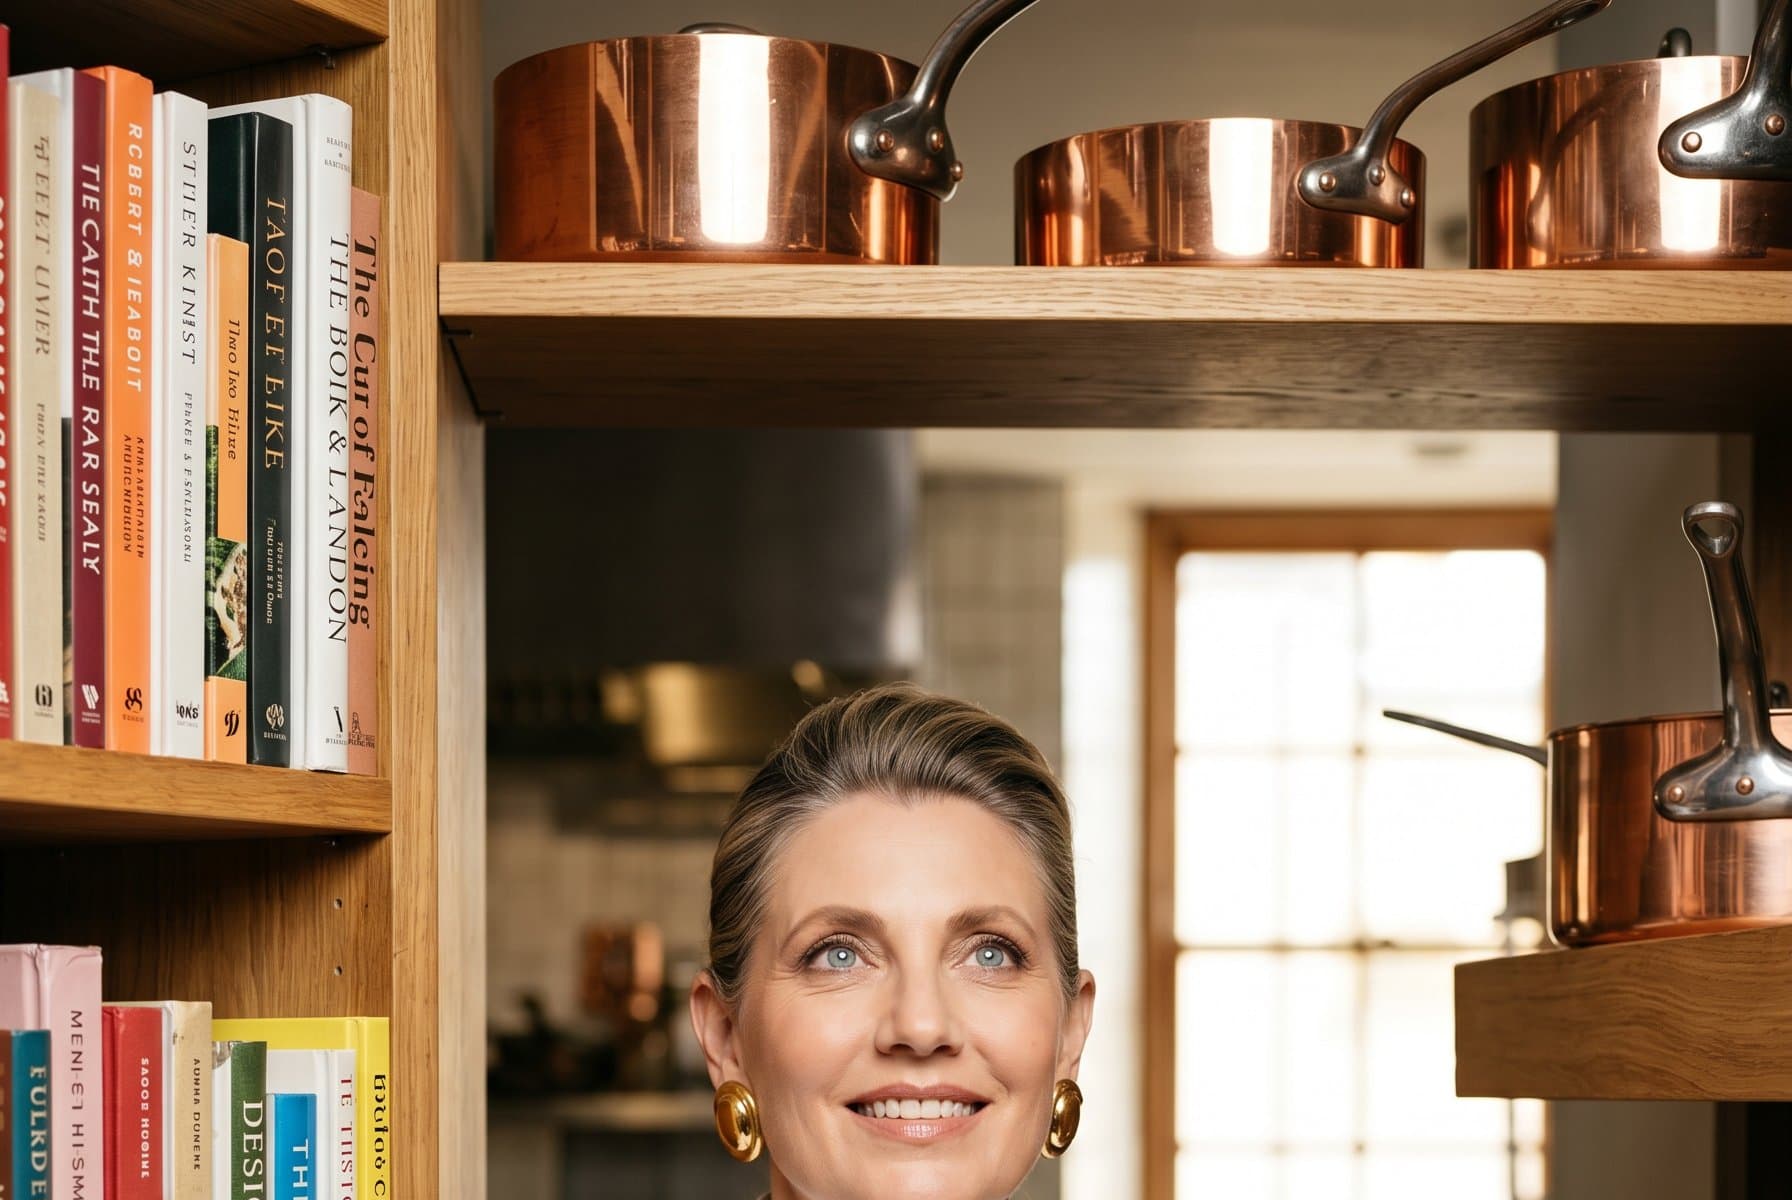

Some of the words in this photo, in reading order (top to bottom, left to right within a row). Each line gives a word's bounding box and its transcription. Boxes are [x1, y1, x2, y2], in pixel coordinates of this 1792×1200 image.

[82, 164, 100, 211] TIE
[329, 233, 348, 311] THE
[354, 235, 377, 318] The
[82, 406, 100, 469] RAR
[328, 430, 348, 454] &
[353, 416, 375, 462] of
[328, 467, 347, 645] LANDON
